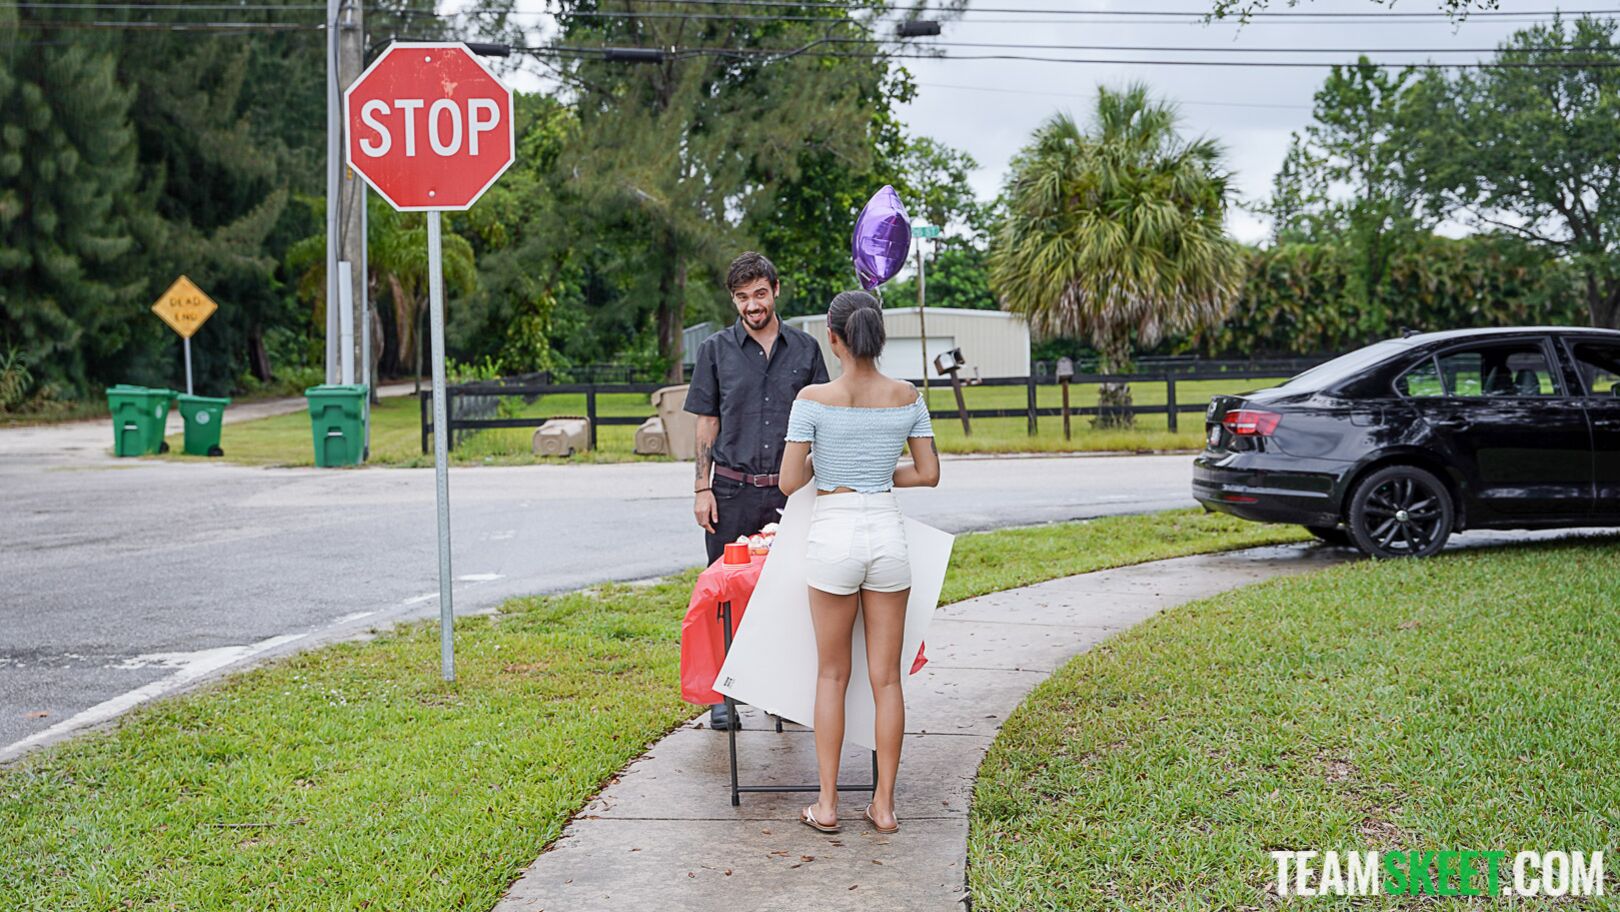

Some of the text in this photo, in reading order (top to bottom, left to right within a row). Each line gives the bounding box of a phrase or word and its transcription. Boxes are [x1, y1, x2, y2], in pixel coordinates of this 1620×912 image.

[359, 98, 500, 157] STOP
[169, 297, 201, 308] DEAD
[175, 311, 198, 322] END
